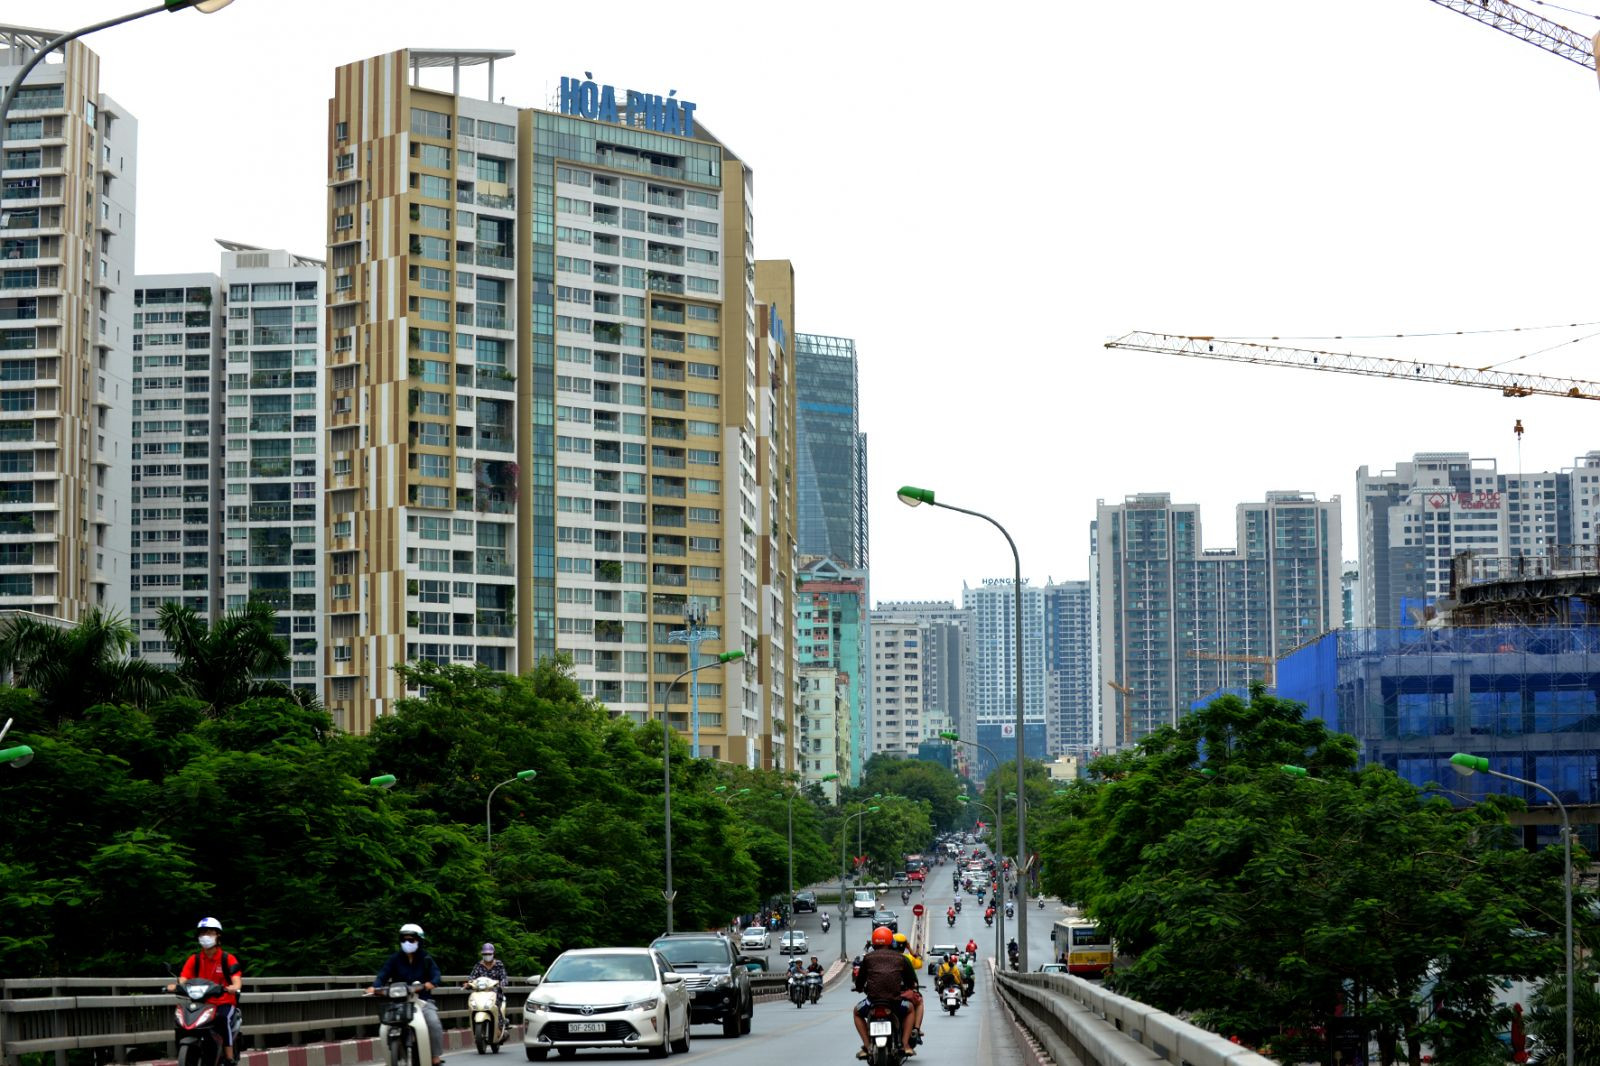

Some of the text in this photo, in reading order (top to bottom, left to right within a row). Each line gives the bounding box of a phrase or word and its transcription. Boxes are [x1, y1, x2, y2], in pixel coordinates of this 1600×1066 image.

[560, 71, 697, 137] HÒA PHÁT
[1461, 501, 1501, 509] COMPLEX
